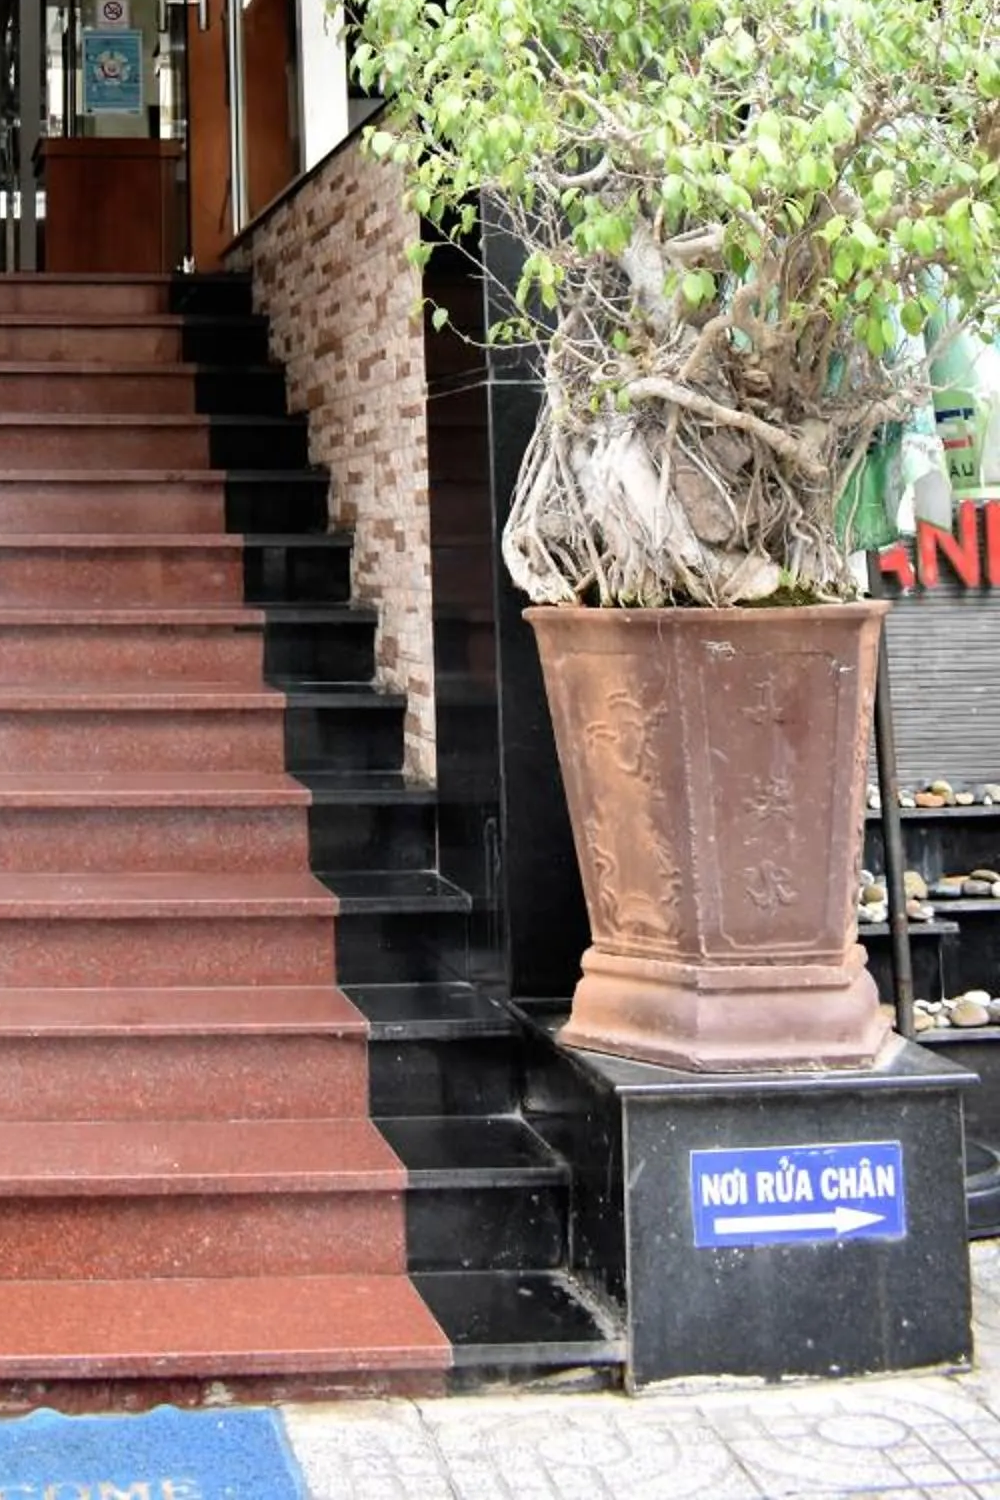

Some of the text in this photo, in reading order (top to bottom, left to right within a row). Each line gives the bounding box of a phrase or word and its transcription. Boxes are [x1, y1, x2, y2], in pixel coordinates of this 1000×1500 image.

[701, 1155, 895, 1206] NƠI RỬA CHÂN
